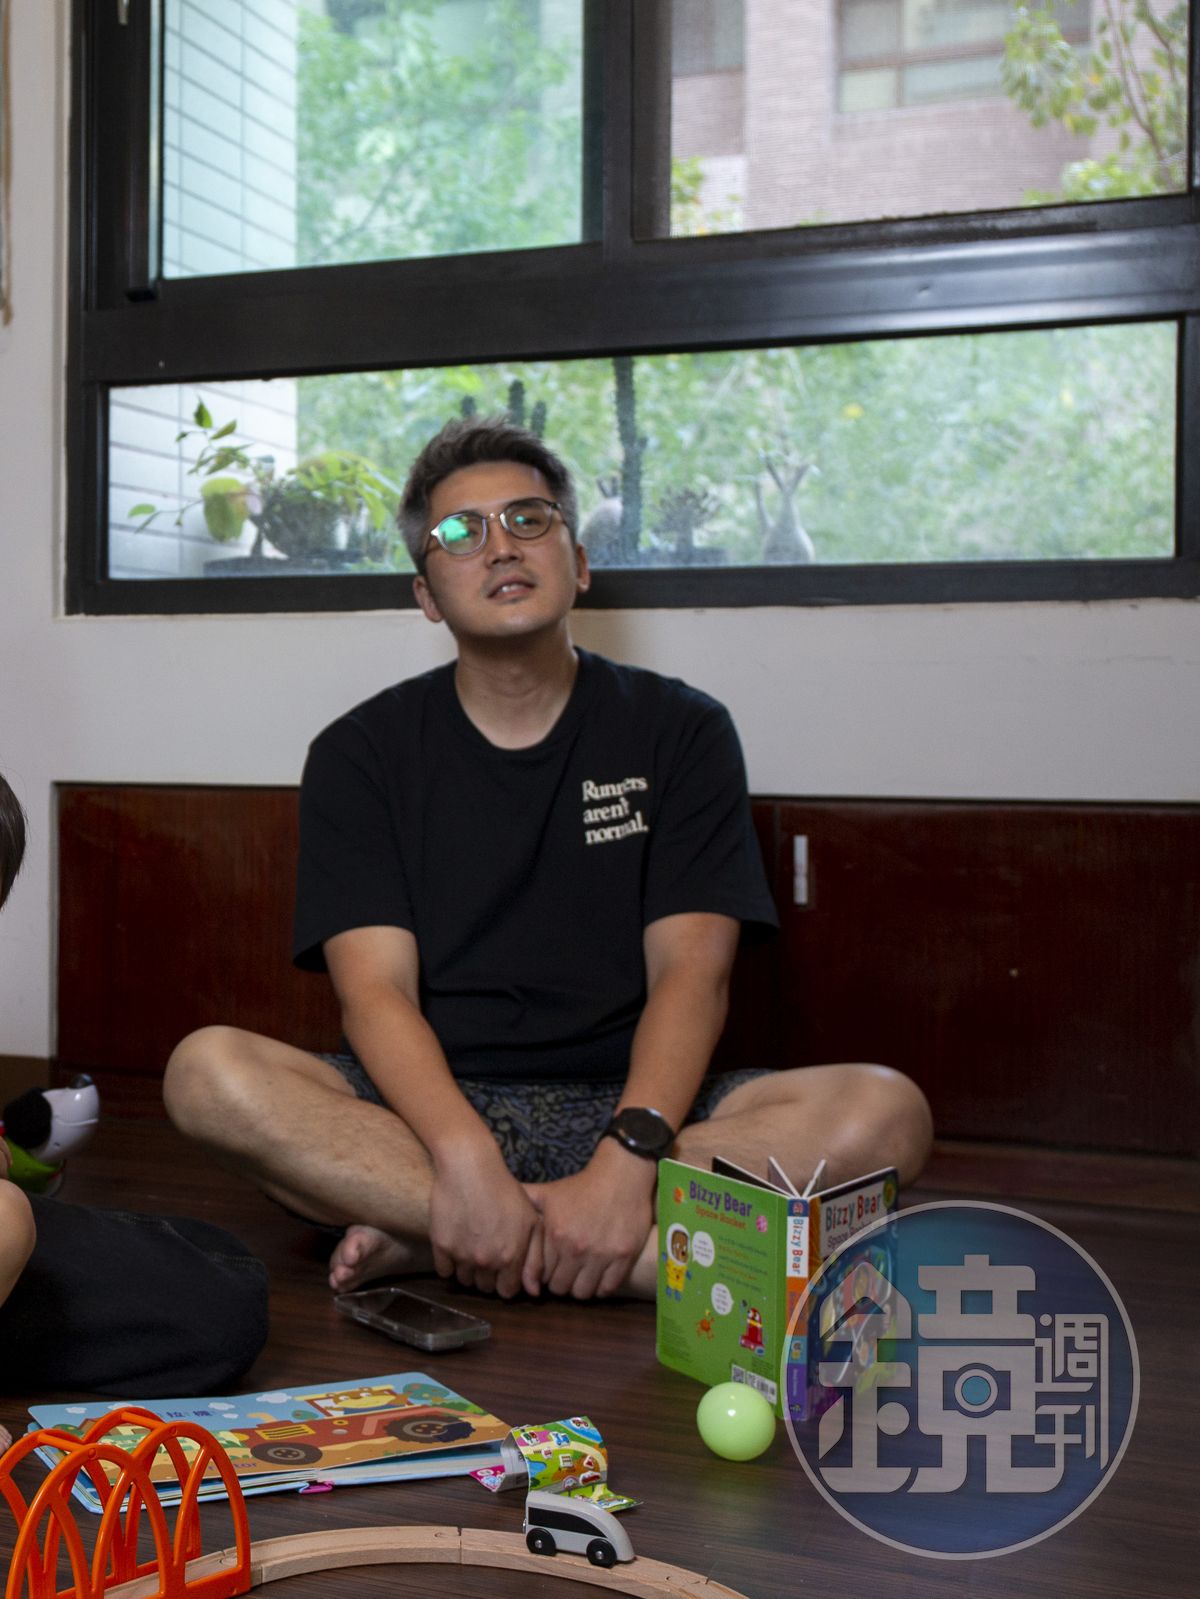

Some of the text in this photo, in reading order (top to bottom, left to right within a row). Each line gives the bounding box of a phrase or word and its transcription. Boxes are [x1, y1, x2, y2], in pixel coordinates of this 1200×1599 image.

[582, 777, 648, 802] Runners
[585, 810, 649, 845] normal.
[689, 1180, 752, 1217] Bizzy Bear
[825, 1202, 855, 1233] Bizzy
[857, 1193, 882, 1220] Bear
[792, 1218, 804, 1274] Bizzy Bear
